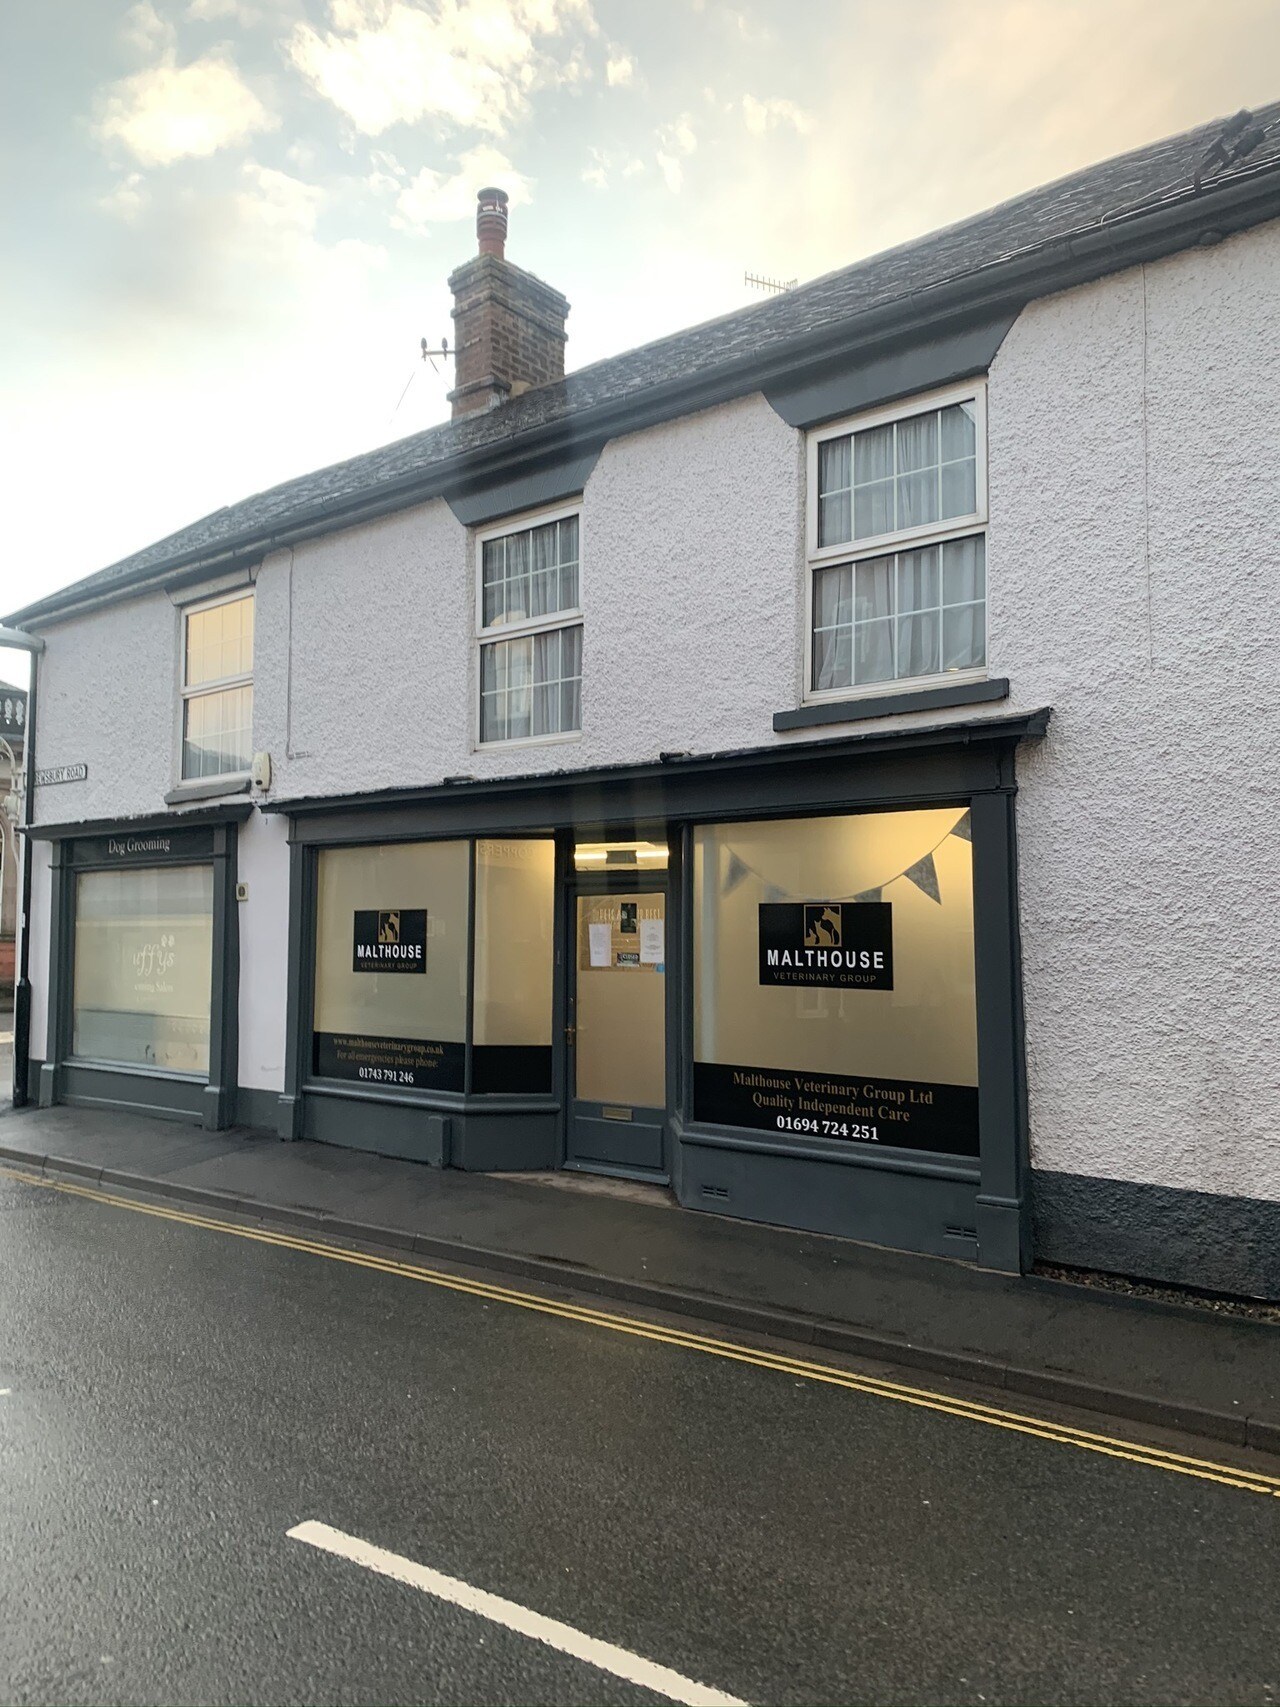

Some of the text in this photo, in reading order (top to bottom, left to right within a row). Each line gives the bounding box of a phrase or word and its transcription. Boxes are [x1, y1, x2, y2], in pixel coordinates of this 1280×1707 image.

[67, 765, 85, 780] ROAD
[108, 836, 170, 856] Dog Grooming
[357, 944, 422, 959] MALTHOUSE
[767, 949, 884, 969] MALTHOUSE
[361, 961, 418, 971] VETERINARY GROUP
[773, 972, 877, 983] VETERINARY GROUP
[333, 1038, 444, 1056] www.malthouseveterinarygroup.co.uk
[337, 1049, 346, 1060] For
[355, 1052, 393, 1064] emergencies
[394, 1055, 415, 1066] please
[359, 1067, 414, 1084] 01743 791 246
[733, 1071, 934, 1105] Malthouse Veterinary Group Ltd
[752, 1091, 911, 1122] Quality Independent Care
[776, 1115, 880, 1141] 01694 724 251
